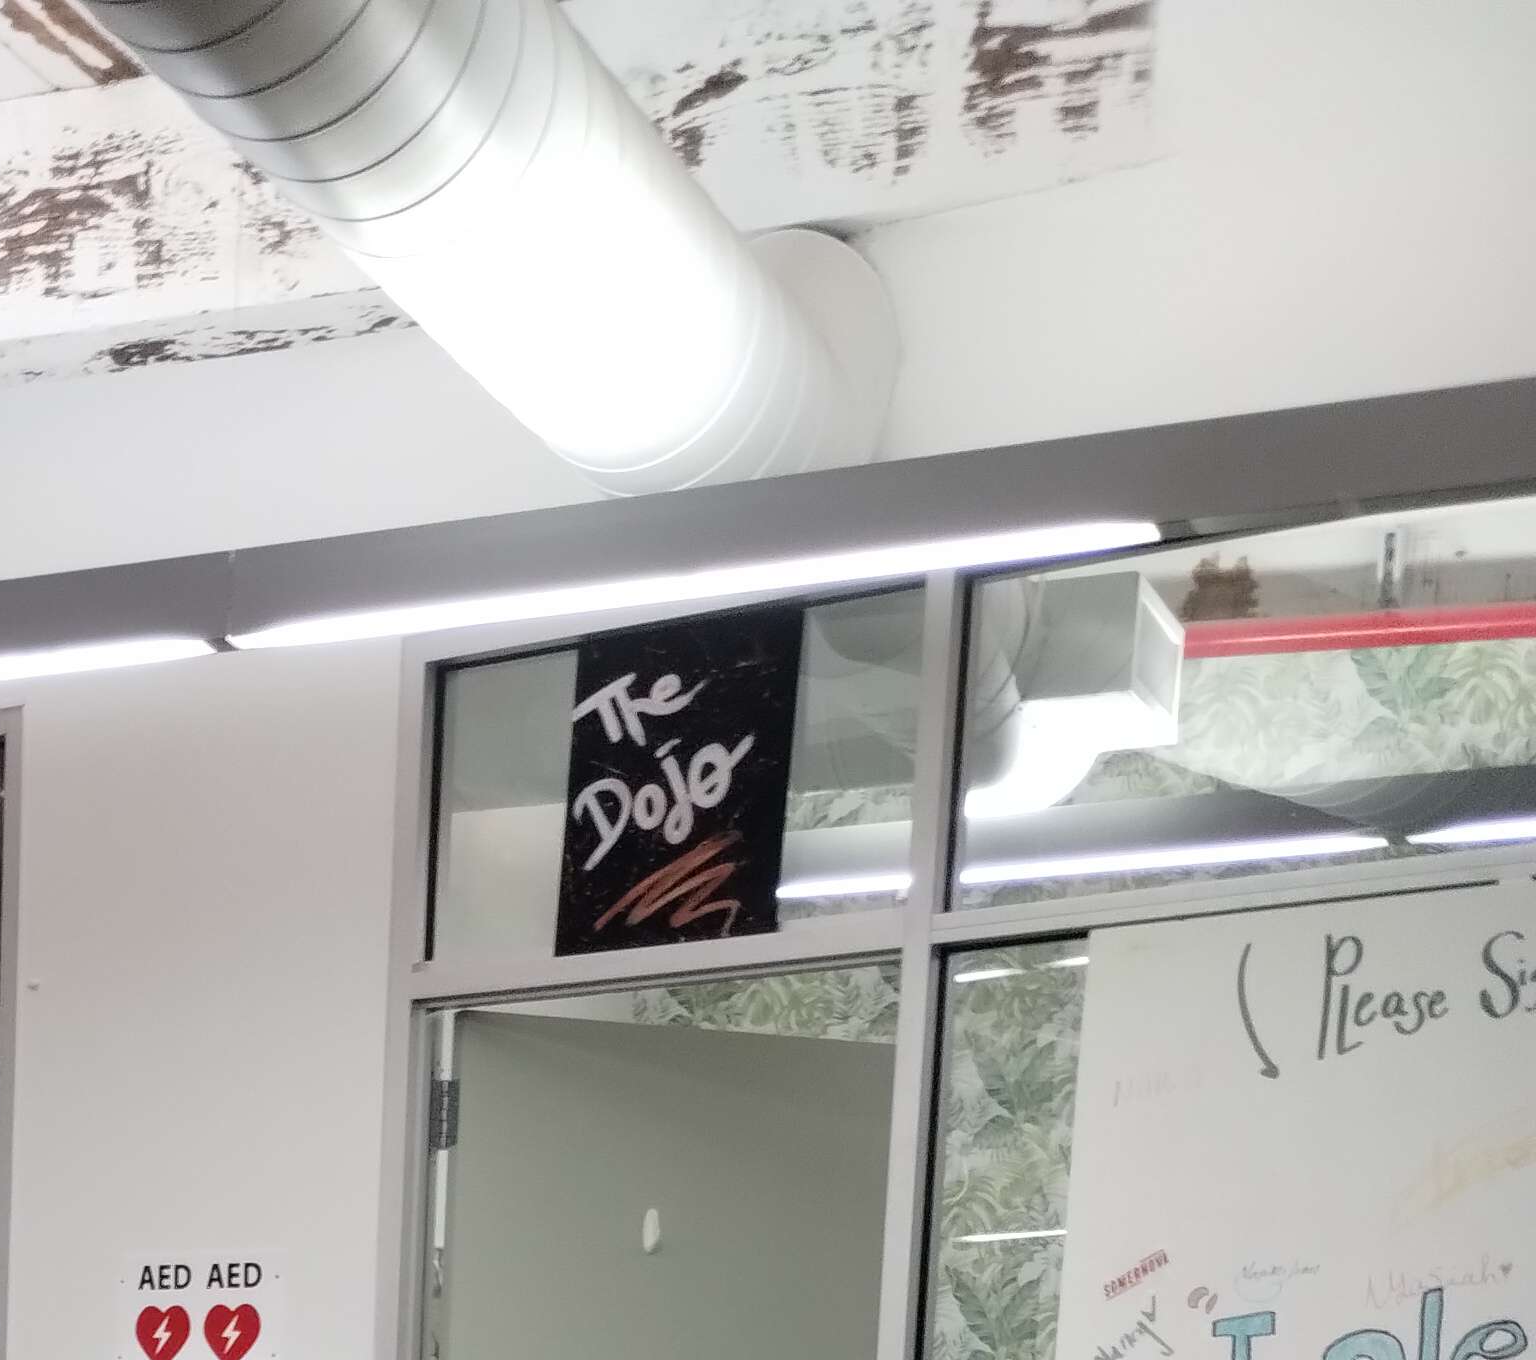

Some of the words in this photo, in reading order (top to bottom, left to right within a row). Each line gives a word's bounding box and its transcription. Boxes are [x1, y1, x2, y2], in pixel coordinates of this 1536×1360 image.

[573, 672, 710, 746] The
[573, 734, 756, 872] Dojo
[1479, 930, 1536, 1019] Si
[138, 1264, 191, 1290] AED
[207, 1262, 262, 1289] AED
